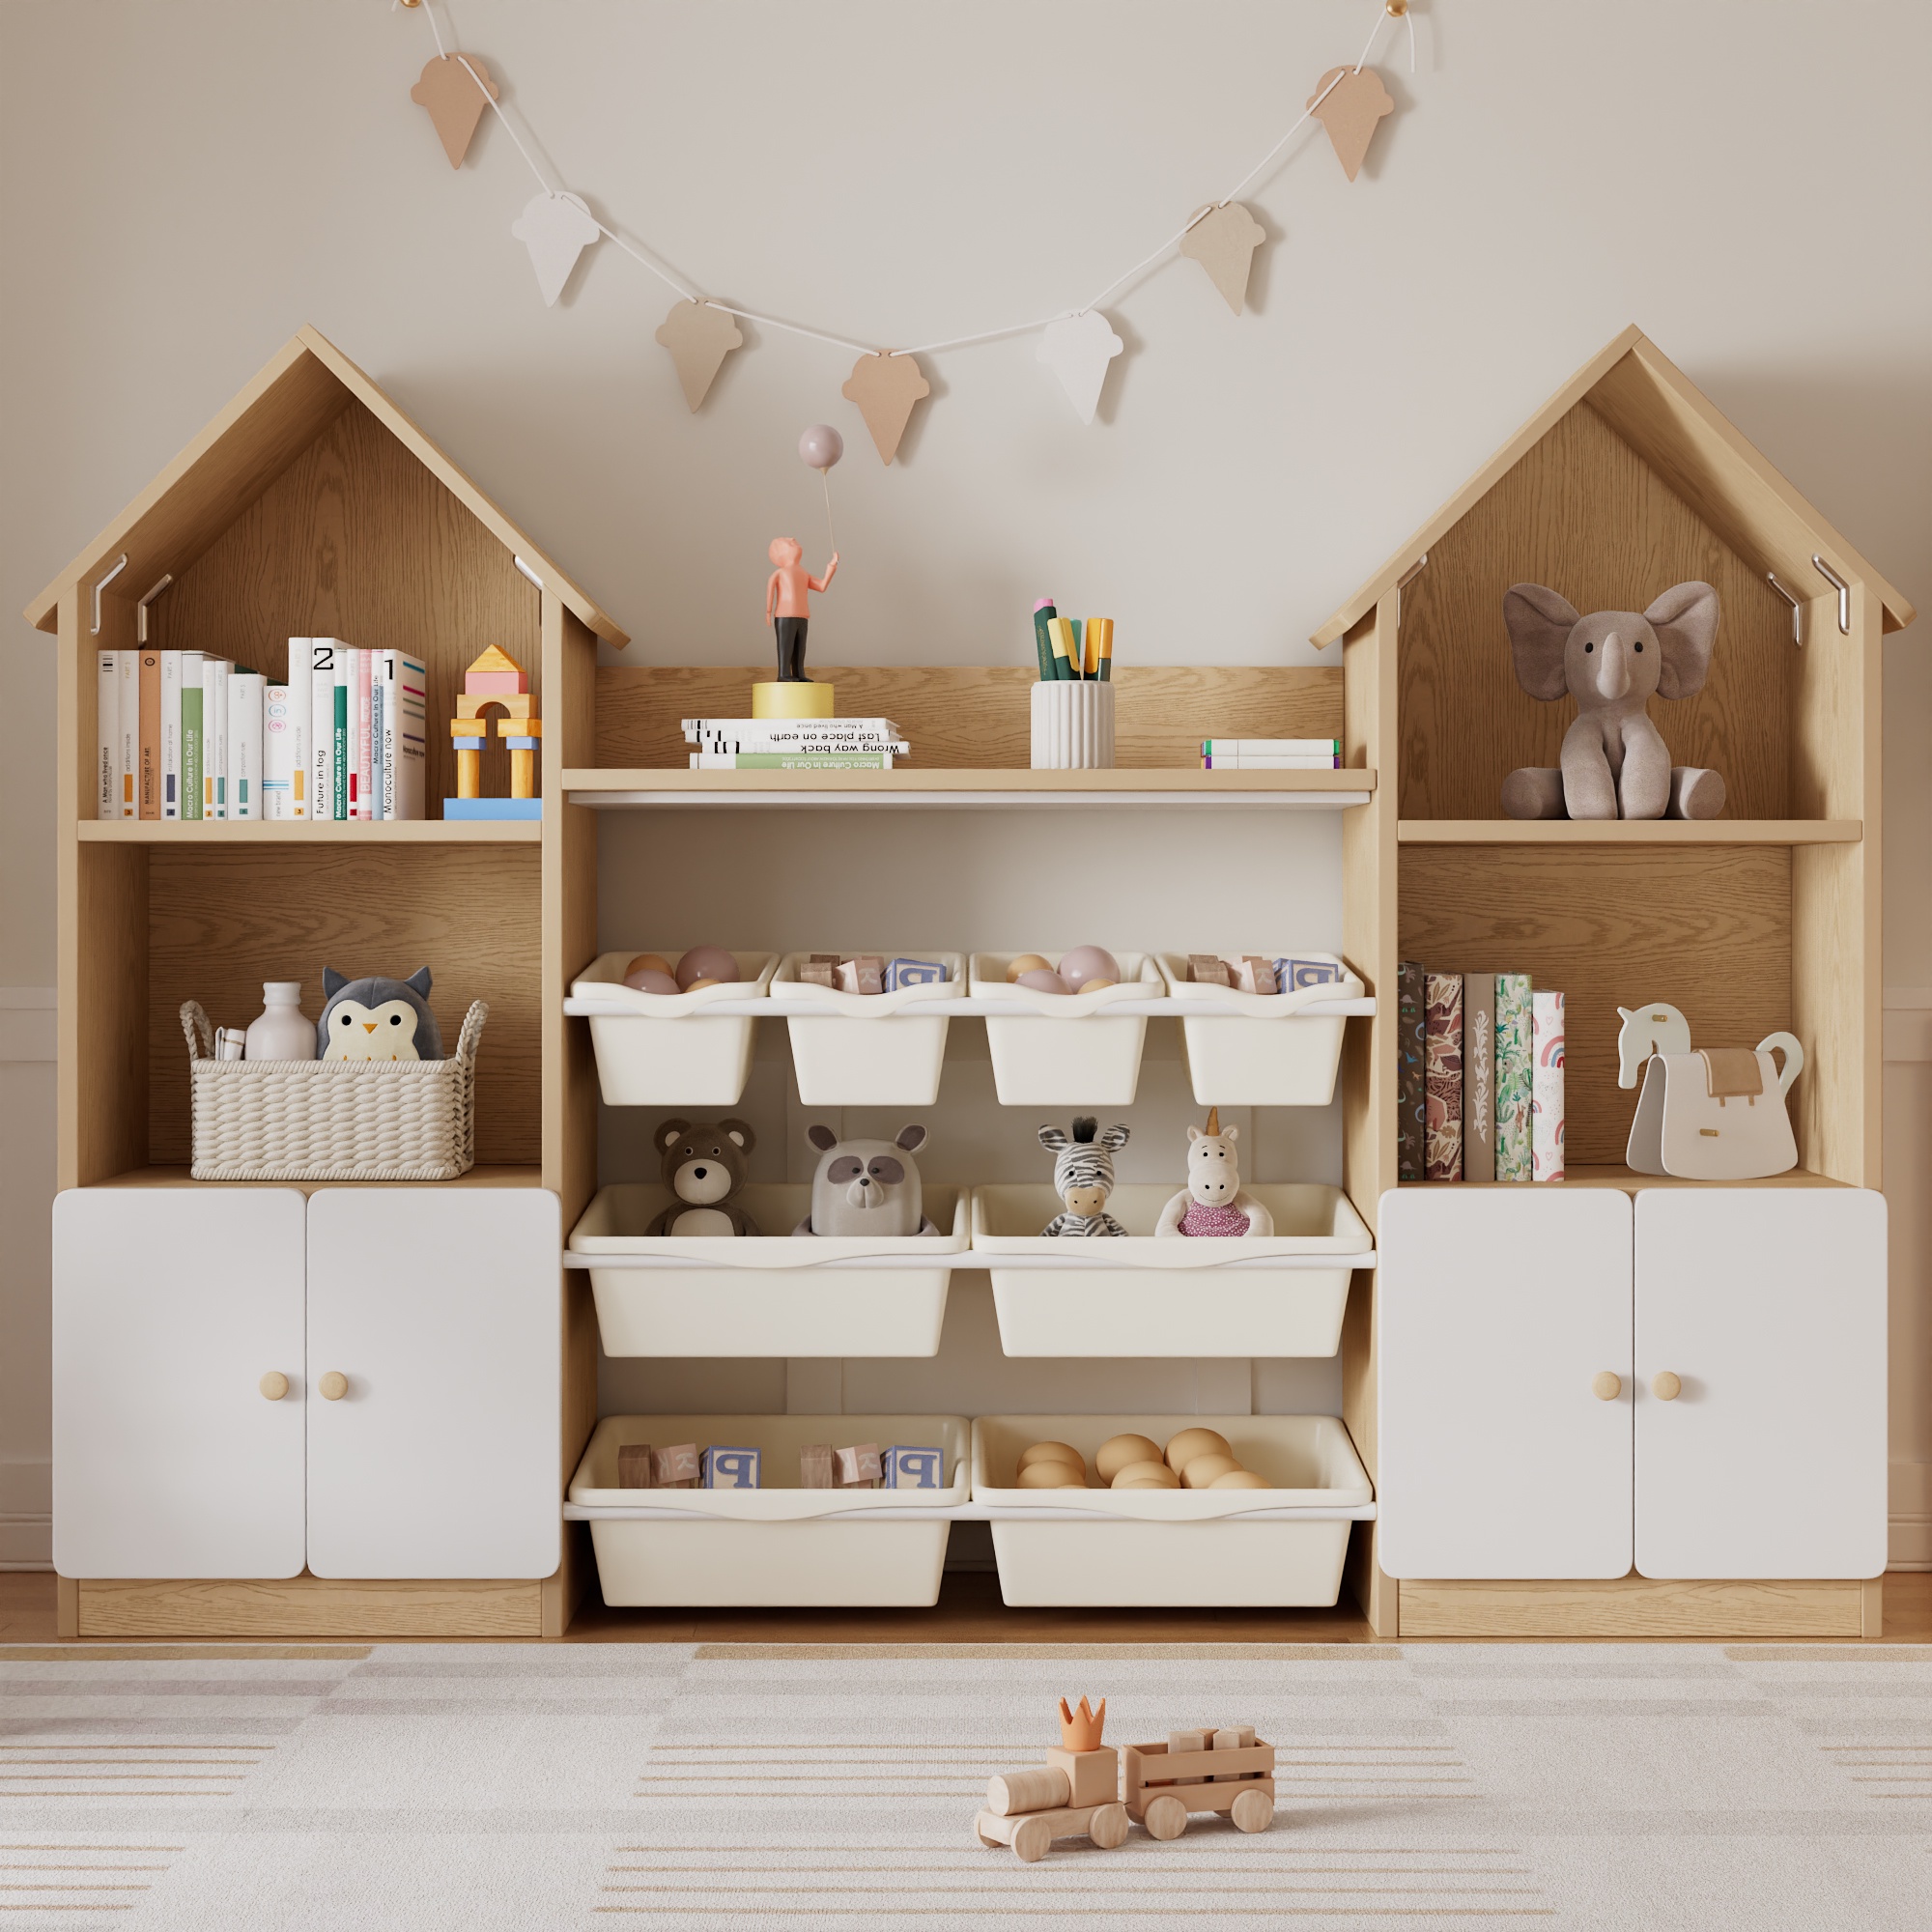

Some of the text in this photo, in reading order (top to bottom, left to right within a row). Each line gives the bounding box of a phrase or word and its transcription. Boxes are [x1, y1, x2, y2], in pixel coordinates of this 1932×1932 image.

[313, 647, 334, 670] 2
[384, 660, 393, 680] 1
[185, 729, 194, 741] Life
[770, 733, 799, 742] earth
[821, 731, 854, 742] place
[858, 733, 879, 742] Last
[185, 743, 194, 756] Our
[801, 745, 831, 753] back
[863, 743, 899, 753] Wrong
[360, 724, 371, 792] BEAUTYFUL
[316, 771, 324, 780] in
[384, 729, 392, 813] Monoculture now
[185, 767, 194, 792] Culture
[185, 795, 194, 818] Macro
